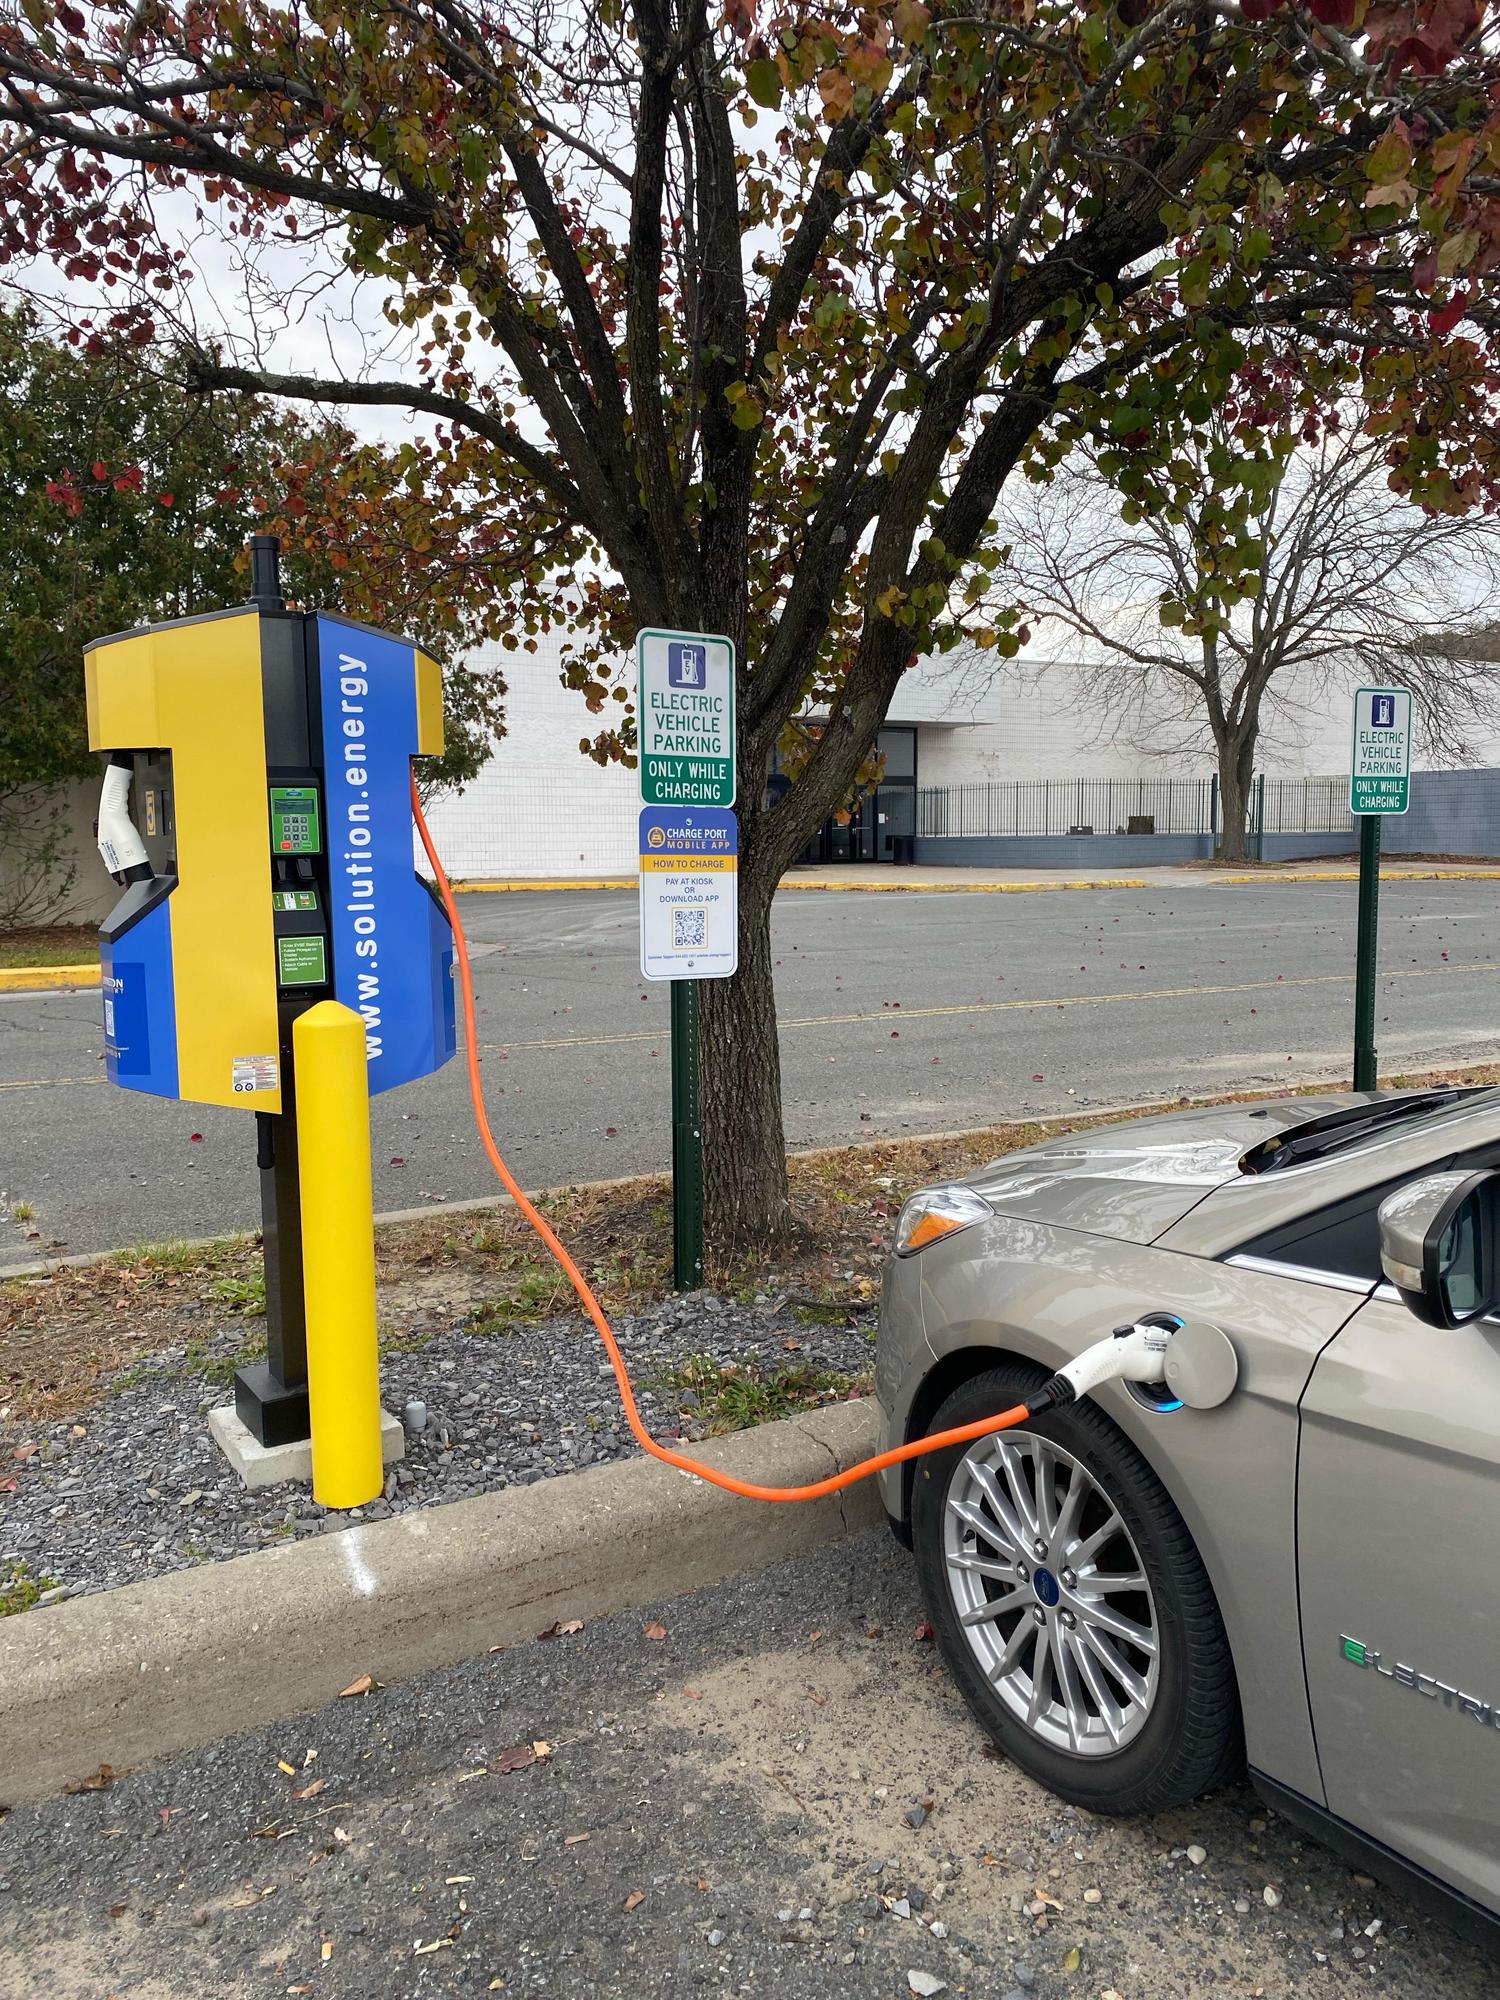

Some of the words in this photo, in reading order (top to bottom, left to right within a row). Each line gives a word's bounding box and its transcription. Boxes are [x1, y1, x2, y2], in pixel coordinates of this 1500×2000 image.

[651, 692, 723, 713] ELECTRIC
[655, 713, 720, 733] VEHICLE
[654, 734, 721, 753] PARKING
[1360, 731, 1404, 744] ELECTRIC
[1362, 746, 1401, 759] VEHICLE
[649, 760, 683, 778] ONLY
[688, 763, 727, 780] WHILE
[1360, 761, 1401, 774] PARKING
[655, 782, 721, 800] CHARGING
[1356, 781, 1378, 793] ONLY
[1380, 781, 1404, 793] WHILE
[1360, 796, 1400, 808] CHARGING
[667, 828, 702, 839] CHARGE
[704, 829, 727, 839] PORT
[667, 841, 706, 850] MOBILE
[711, 841, 730, 850] APP
[339, 654, 383, 1060] www.solution.energy
[653, 860, 674, 868] HOW
[676, 860, 688, 868] TO
[689, 859, 724, 869] CHARGE
[659, 895, 703, 903] DOWNLOAD
[1339, 1633, 1500, 1730] ELECTRI
